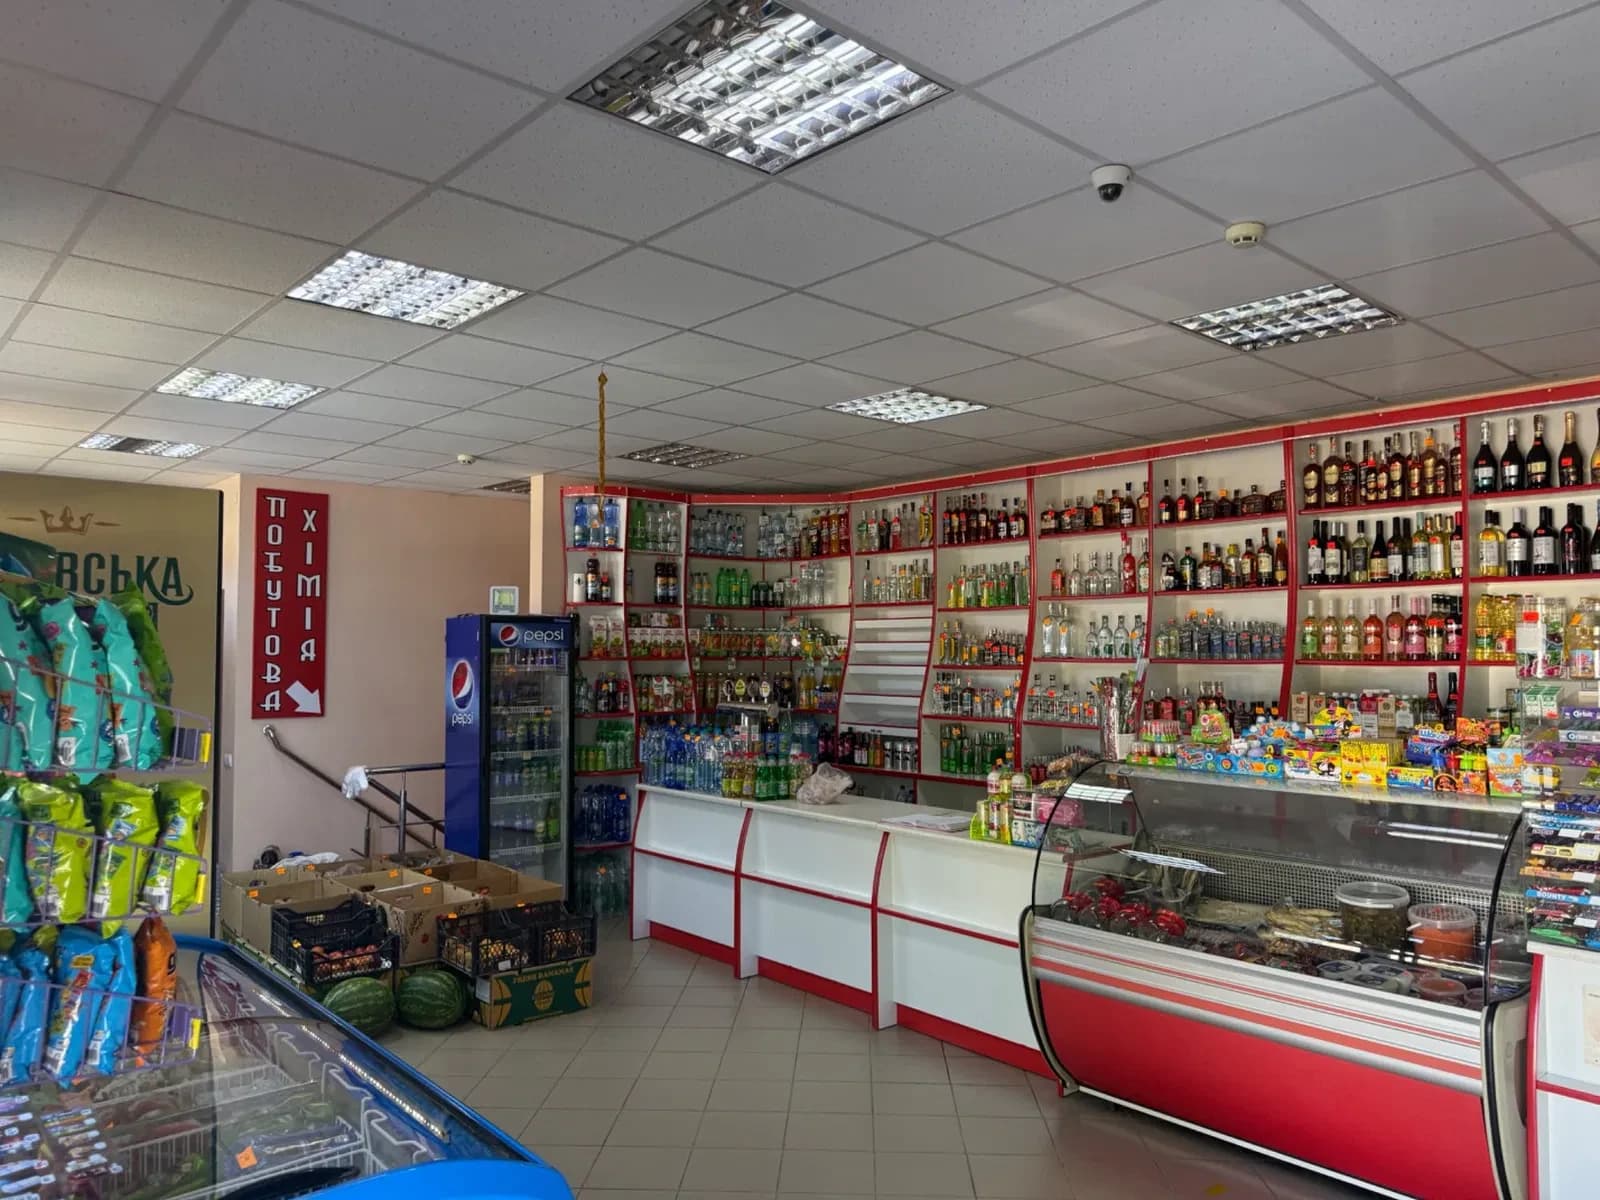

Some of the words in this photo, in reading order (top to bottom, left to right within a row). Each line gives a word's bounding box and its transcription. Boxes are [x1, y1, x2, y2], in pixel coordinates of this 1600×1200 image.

[261, 496, 287, 711] ПОБУТОВА
[297, 509, 322, 662] ХІМІЯ
[523, 628, 564, 643] pepsi
[451, 711, 473, 726] pepsi
